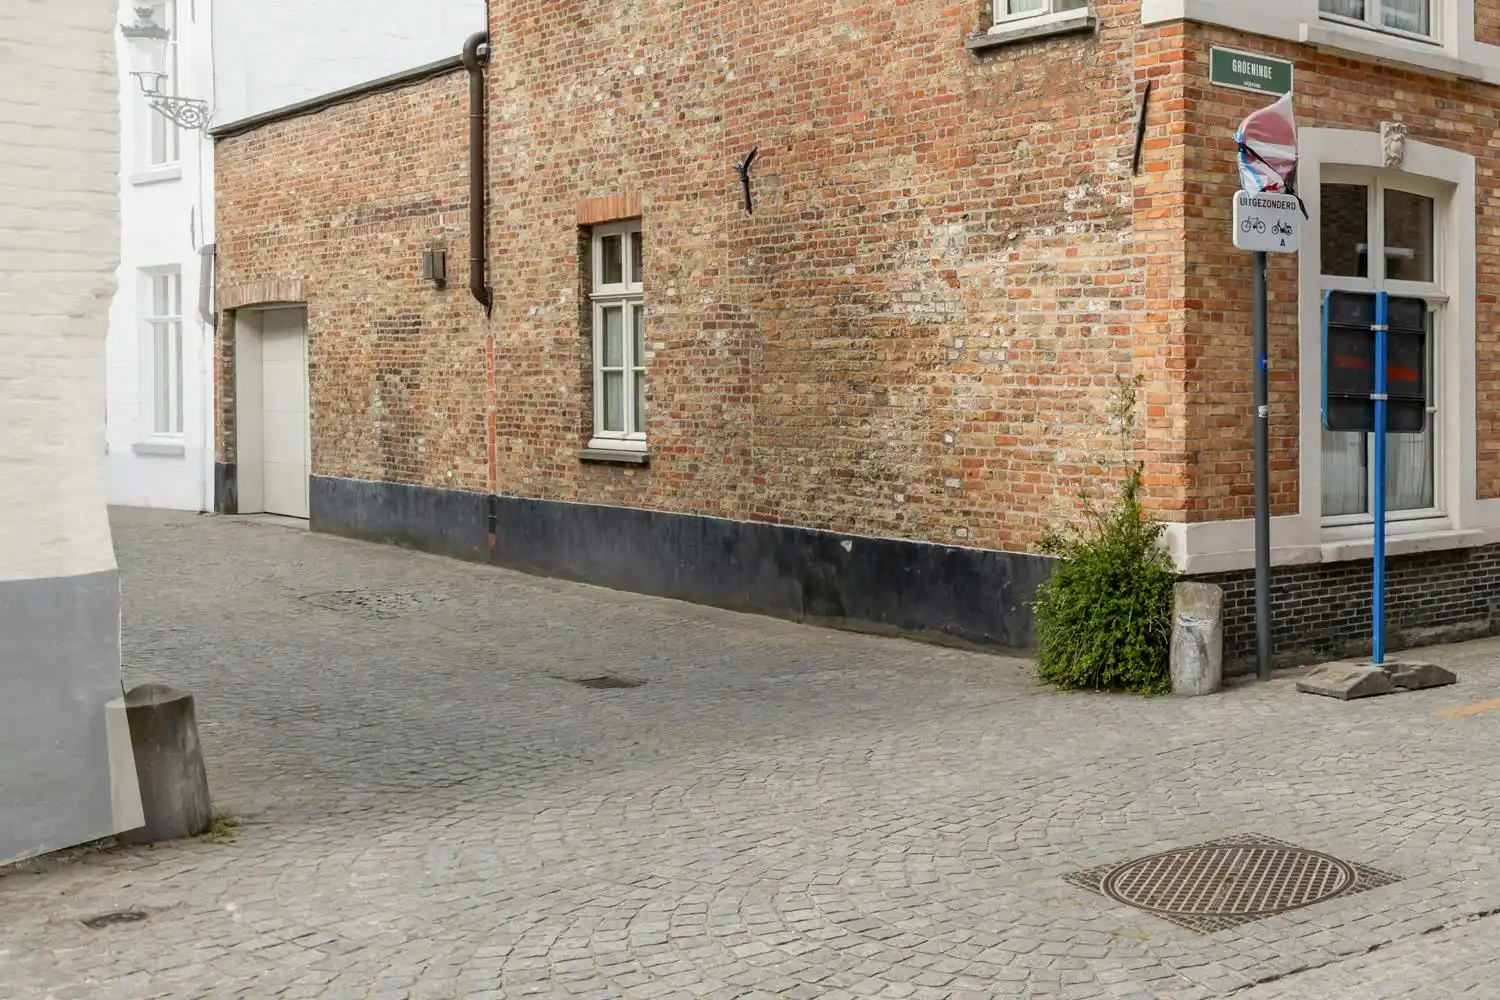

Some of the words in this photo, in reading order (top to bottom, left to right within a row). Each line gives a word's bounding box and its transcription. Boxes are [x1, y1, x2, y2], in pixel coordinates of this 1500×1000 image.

[1232, 59, 1272, 79] GROENINGE
[1240, 197, 1296, 210] UITGEZONDERD
[1280, 238, 1286, 247] A
